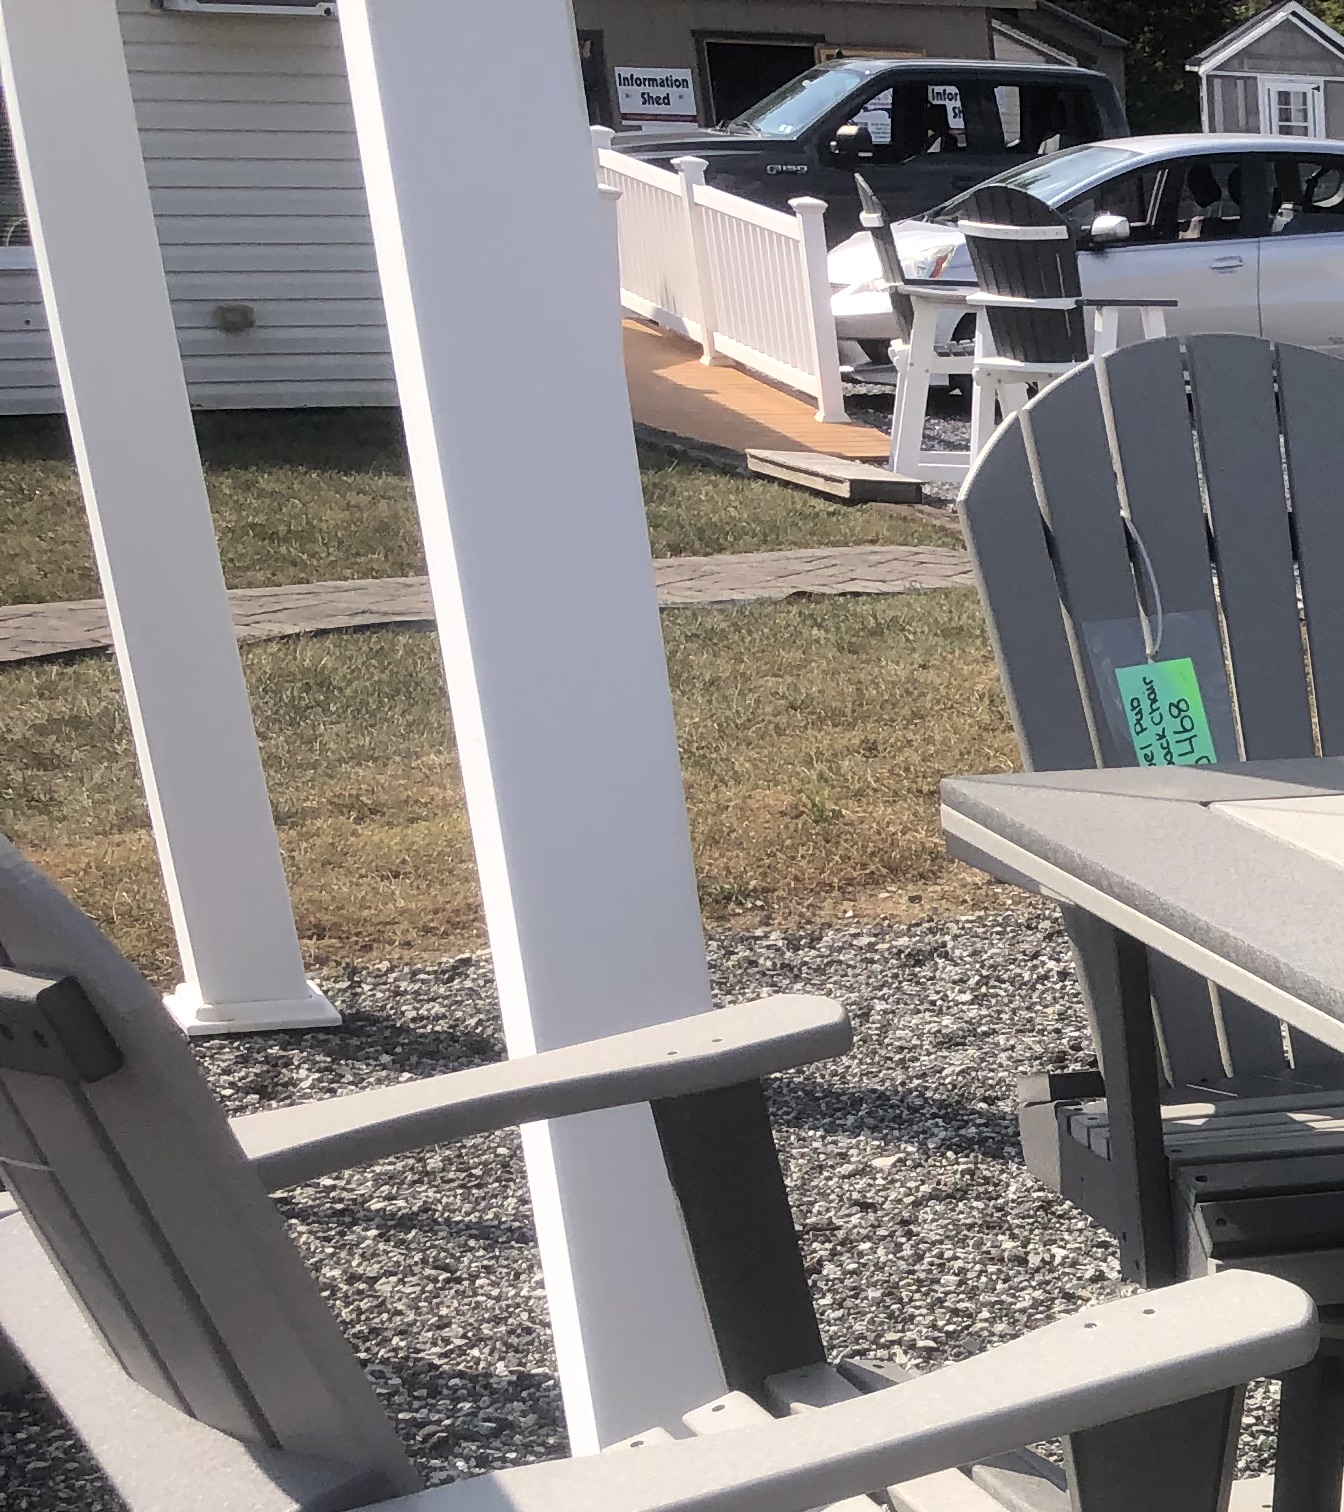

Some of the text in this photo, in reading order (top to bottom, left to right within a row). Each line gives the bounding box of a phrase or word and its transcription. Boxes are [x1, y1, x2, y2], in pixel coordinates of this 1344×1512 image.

[618, 73, 689, 89] Information
[640, 92, 671, 106] Shed
[1143, 676, 1164, 727] Chair
[1130, 696, 1148, 737] Pub
